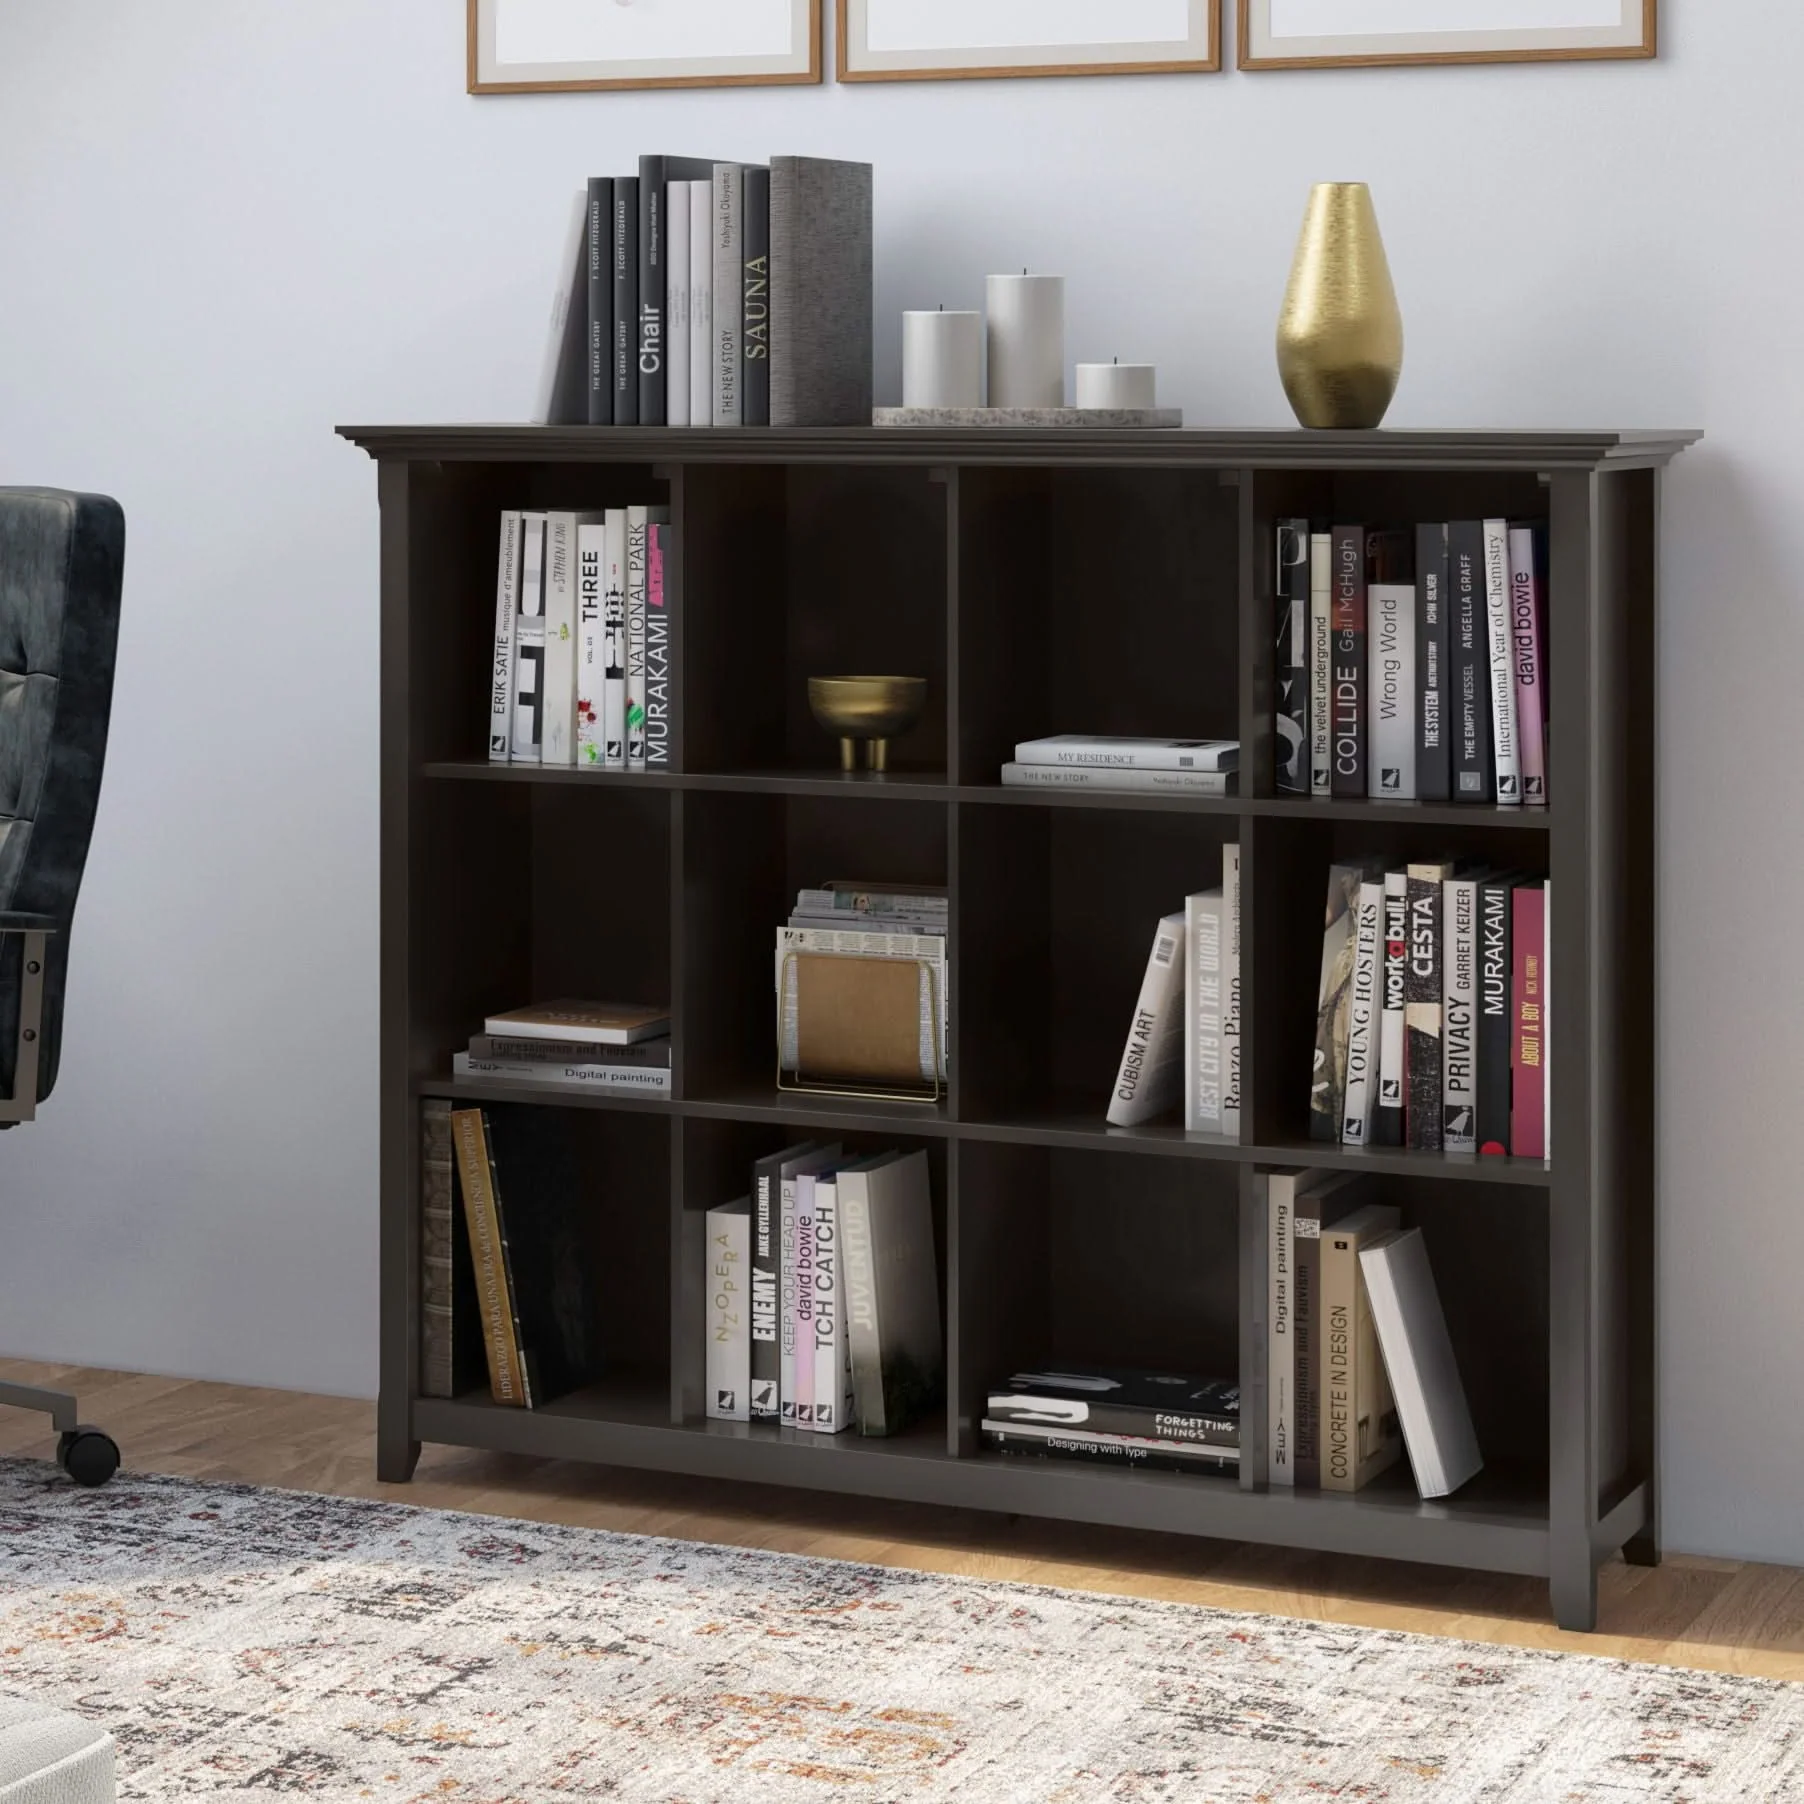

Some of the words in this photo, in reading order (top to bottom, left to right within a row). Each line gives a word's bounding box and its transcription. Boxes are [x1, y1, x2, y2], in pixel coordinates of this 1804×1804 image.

[721, 172, 731, 209] Okuyama
[721, 209, 731, 249] Yoshiyuki
[746, 255, 767, 359] SAUNA
[639, 303, 660, 374] Chair
[722, 330, 733, 363] STORY
[722, 365, 733, 390] NEW
[722, 392, 733, 415] THE
[505, 519, 515, 590] d'ameublement
[555, 523, 566, 545] KING
[629, 524, 645, 571] PARK
[553, 547, 566, 584] STEPHEN
[583, 552, 598, 622] THREE
[1339, 539, 1357, 612] McHugh
[1427, 573, 1437, 600] SILVER
[1460, 554, 1472, 592] GRAFF
[1488, 534, 1504, 608] Chemistry
[503, 593, 513, 631] musique
[1427, 603, 1437, 624] JOHN
[1462, 596, 1473, 649] ANGELLA
[1491, 611, 1505, 627] of
[1511, 572, 1532, 630] bowie
[629, 579, 645, 677] NATIONAL
[1339, 620, 1354, 652] Gail
[1380, 599, 1397, 653] World
[1493, 632, 1506, 664] Year
[495, 635, 509, 676] SATIE
[1315, 616, 1329, 694] underground
[1514, 634, 1535, 686] david
[493, 681, 506, 714] ERIK
[647, 614, 668, 762] MURAKAMI
[1380, 659, 1400, 719] Wrong
[1464, 664, 1474, 700] VESSEL
[1314, 697, 1326, 731] velvet
[1336, 666, 1357, 775] COLLIDE
[1425, 690, 1439, 729] SYSTEM
[1464, 703, 1475, 738] EMPTY
[1493, 668, 1511, 758] International
[1058, 752, 1074, 762] MY
[1077, 753, 1136, 765] RESIDENCE
[1315, 735, 1326, 754] the
[1425, 729, 1439, 748] THE
[1465, 743, 1475, 760] THE
[1024, 772, 1038, 781] THE
[1041, 773, 1061, 782] NEW
[1063, 774, 1089, 783] STORY
[1456, 888, 1470, 937] KEIZER
[1200, 913, 1219, 972] WORLD
[1355, 904, 1377, 1003] HOSTERS
[1412, 896, 1433, 977] CESTA
[1484, 889, 1504, 1015] MURAKAMI
[1456, 939, 1470, 990] GARRET
[1200, 975, 1219, 1007] THE
[1224, 977, 1240, 1037] Piano
[1521, 1001, 1539, 1021] BOY
[1349, 1008, 1370, 1085] YOUNG
[1448, 996, 1470, 1092] PRIVACY
[1523, 1024, 1539, 1032] A
[1118, 1042, 1147, 1101] CUBISM
[1135, 1008, 1156, 1043] ART
[1200, 1036, 1219, 1075] CITY
[1521, 1036, 1539, 1067] ABOUT
[564, 1068, 607, 1081] Digital
[611, 1073, 664, 1086] painting
[1200, 1076, 1219, 1121] BEST
[1224, 1046, 1240, 1110] Renzo
[462, 1118, 478, 1171] SUPERIOR
[758, 1175, 770, 1233] GYLLENHAAL
[783, 1188, 796, 1210] UP
[758, 1234, 770, 1257] JAKE
[783, 1217, 796, 1260] HEAD
[796, 1215, 812, 1269] bowie
[815, 1207, 834, 1292] CATCH
[1276, 1205, 1288, 1274] painting
[845, 1199, 873, 1331] JUVENTUD
[488, 1279, 500, 1303] UNA
[752, 1267, 777, 1341] ENEMY
[783, 1264, 796, 1313] YOUR
[797, 1273, 812, 1321] david
[1276, 1279, 1288, 1334] Digital
[493, 1306, 505, 1335] PARA
[783, 1316, 796, 1356] KEEP
[815, 1300, 834, 1350] TCH
[1331, 1305, 1348, 1367] DESIGN
[1331, 1370, 1348, 1386] IN
[1155, 1414, 1235, 1432] FORGETTING
[1155, 1426, 1206, 1440] THINGS
[1331, 1390, 1348, 1479] CONCRETE
[1048, 1436, 1097, 1454] Designing
[1100, 1442, 1122, 1455] with
[1125, 1446, 1148, 1458] Type
